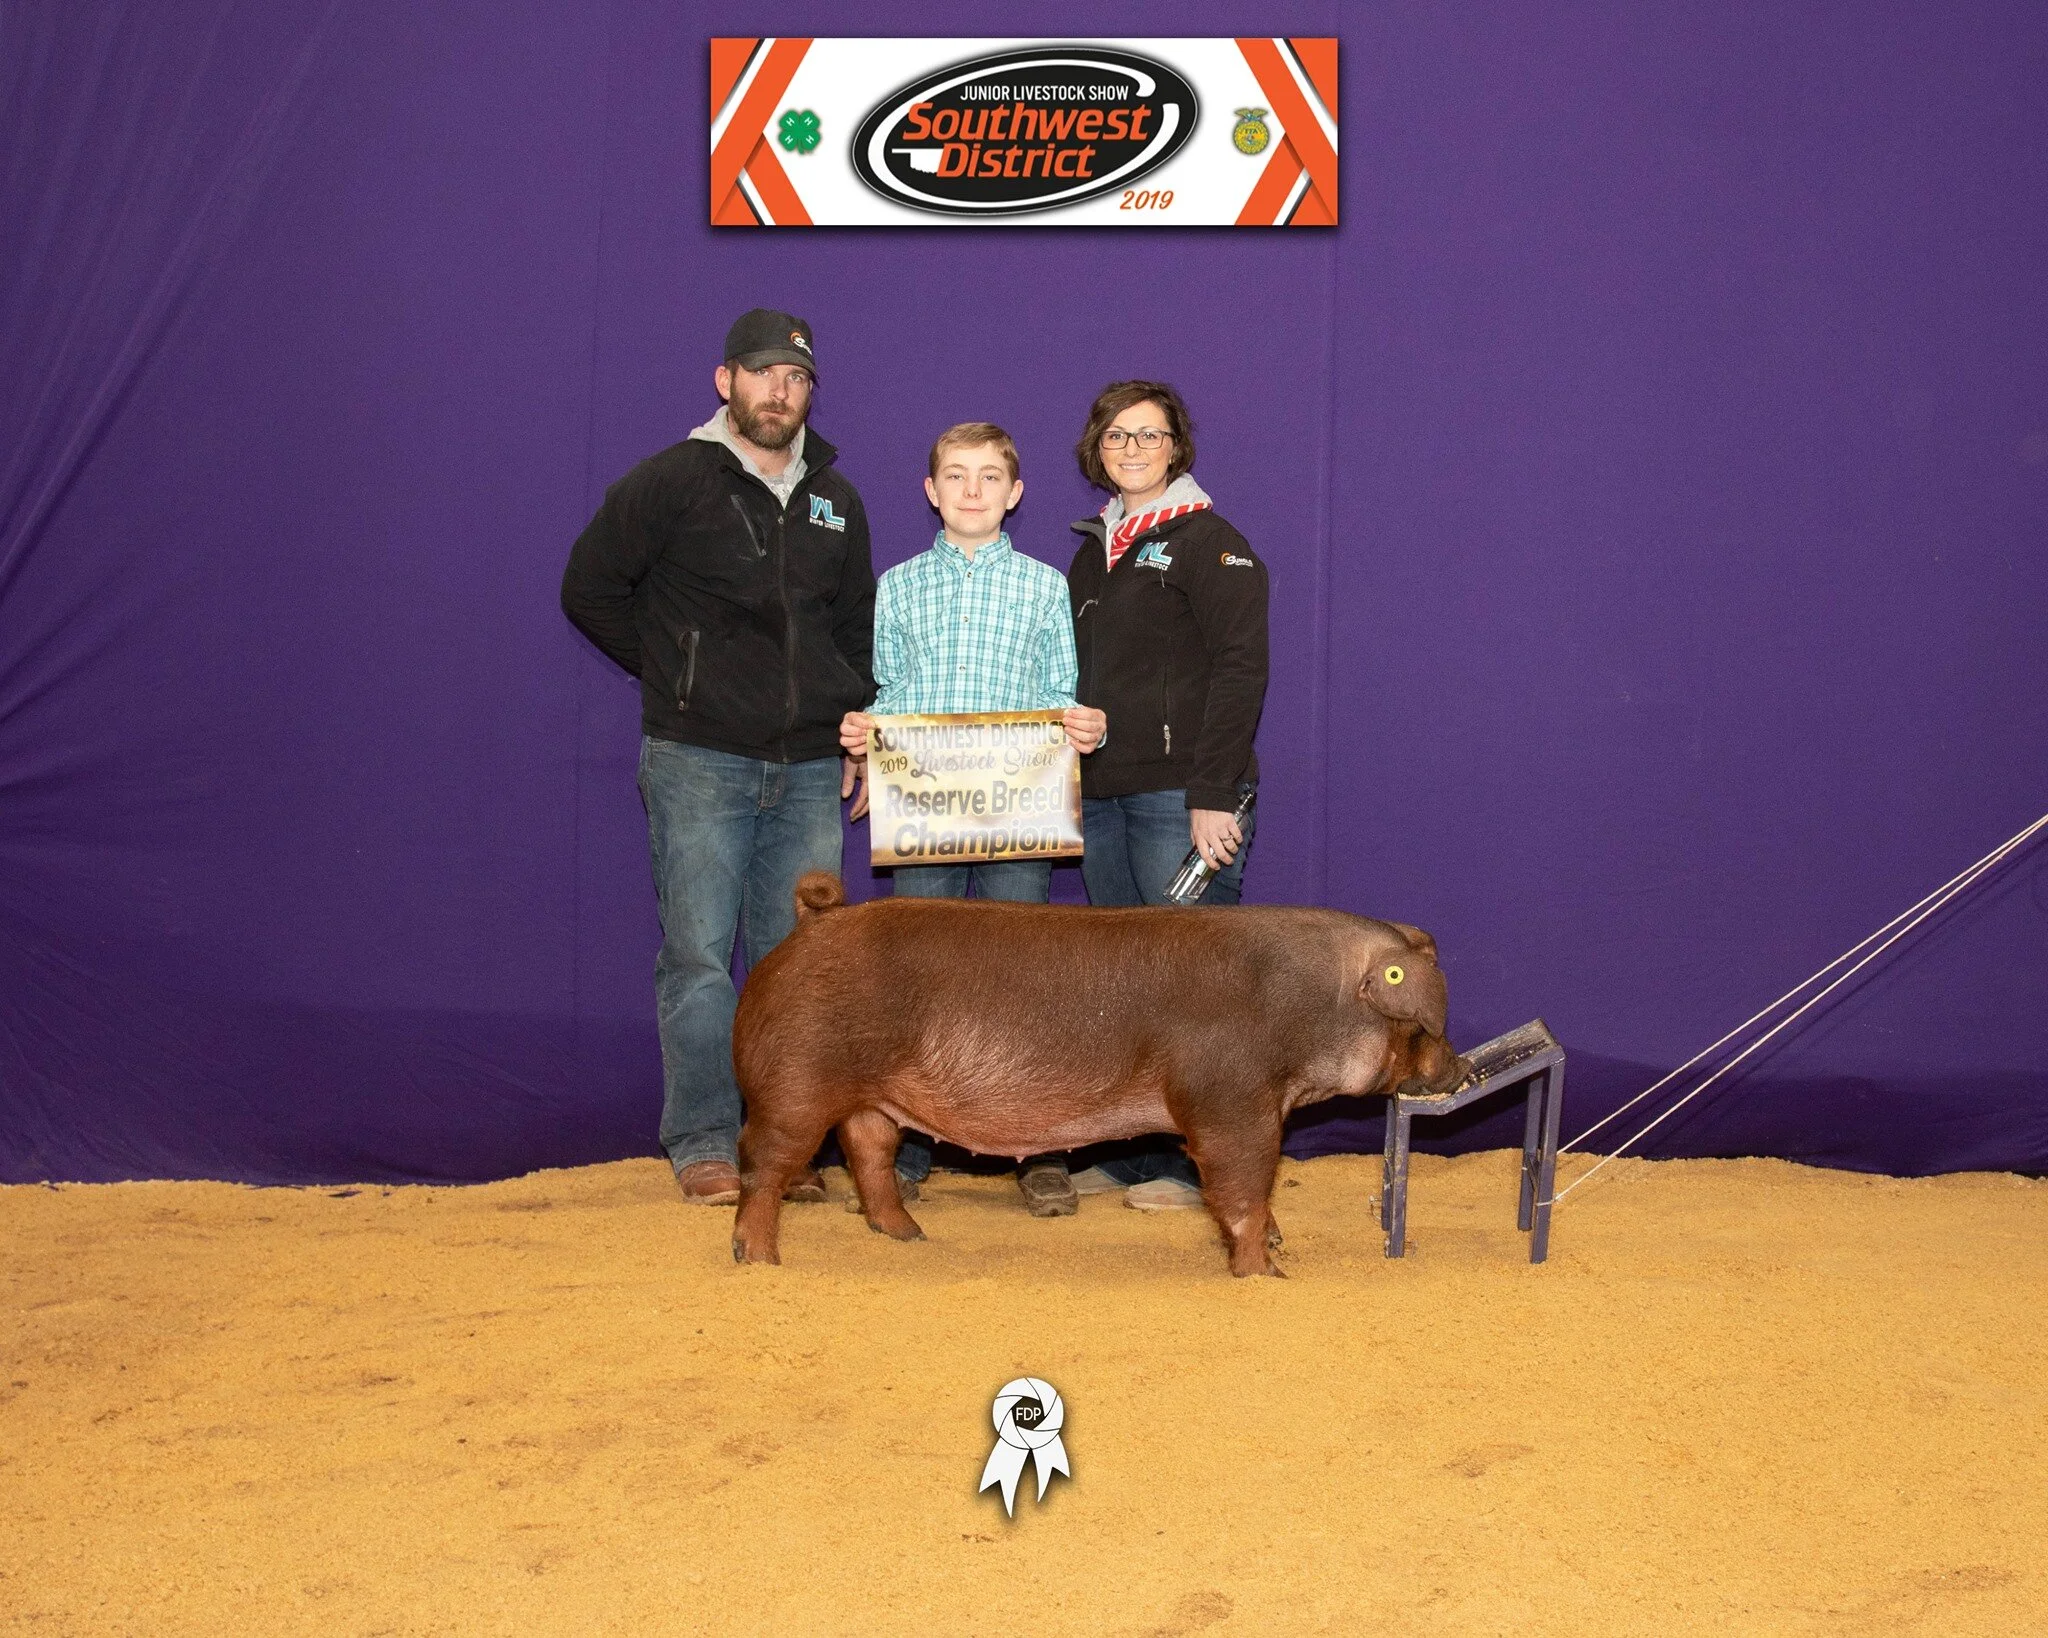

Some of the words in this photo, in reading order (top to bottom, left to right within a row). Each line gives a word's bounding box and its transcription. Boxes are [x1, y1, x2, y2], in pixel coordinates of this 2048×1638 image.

[874, 723, 985, 752] SOUTHWEST
[880, 756, 908, 775] 2019
[910, 748, 997, 782] Livestock
[1003, 747, 1060, 776] Show
[885, 783, 987, 818] Reserve
[991, 775, 1065, 815] Breed
[894, 820, 1060, 859] Champion
